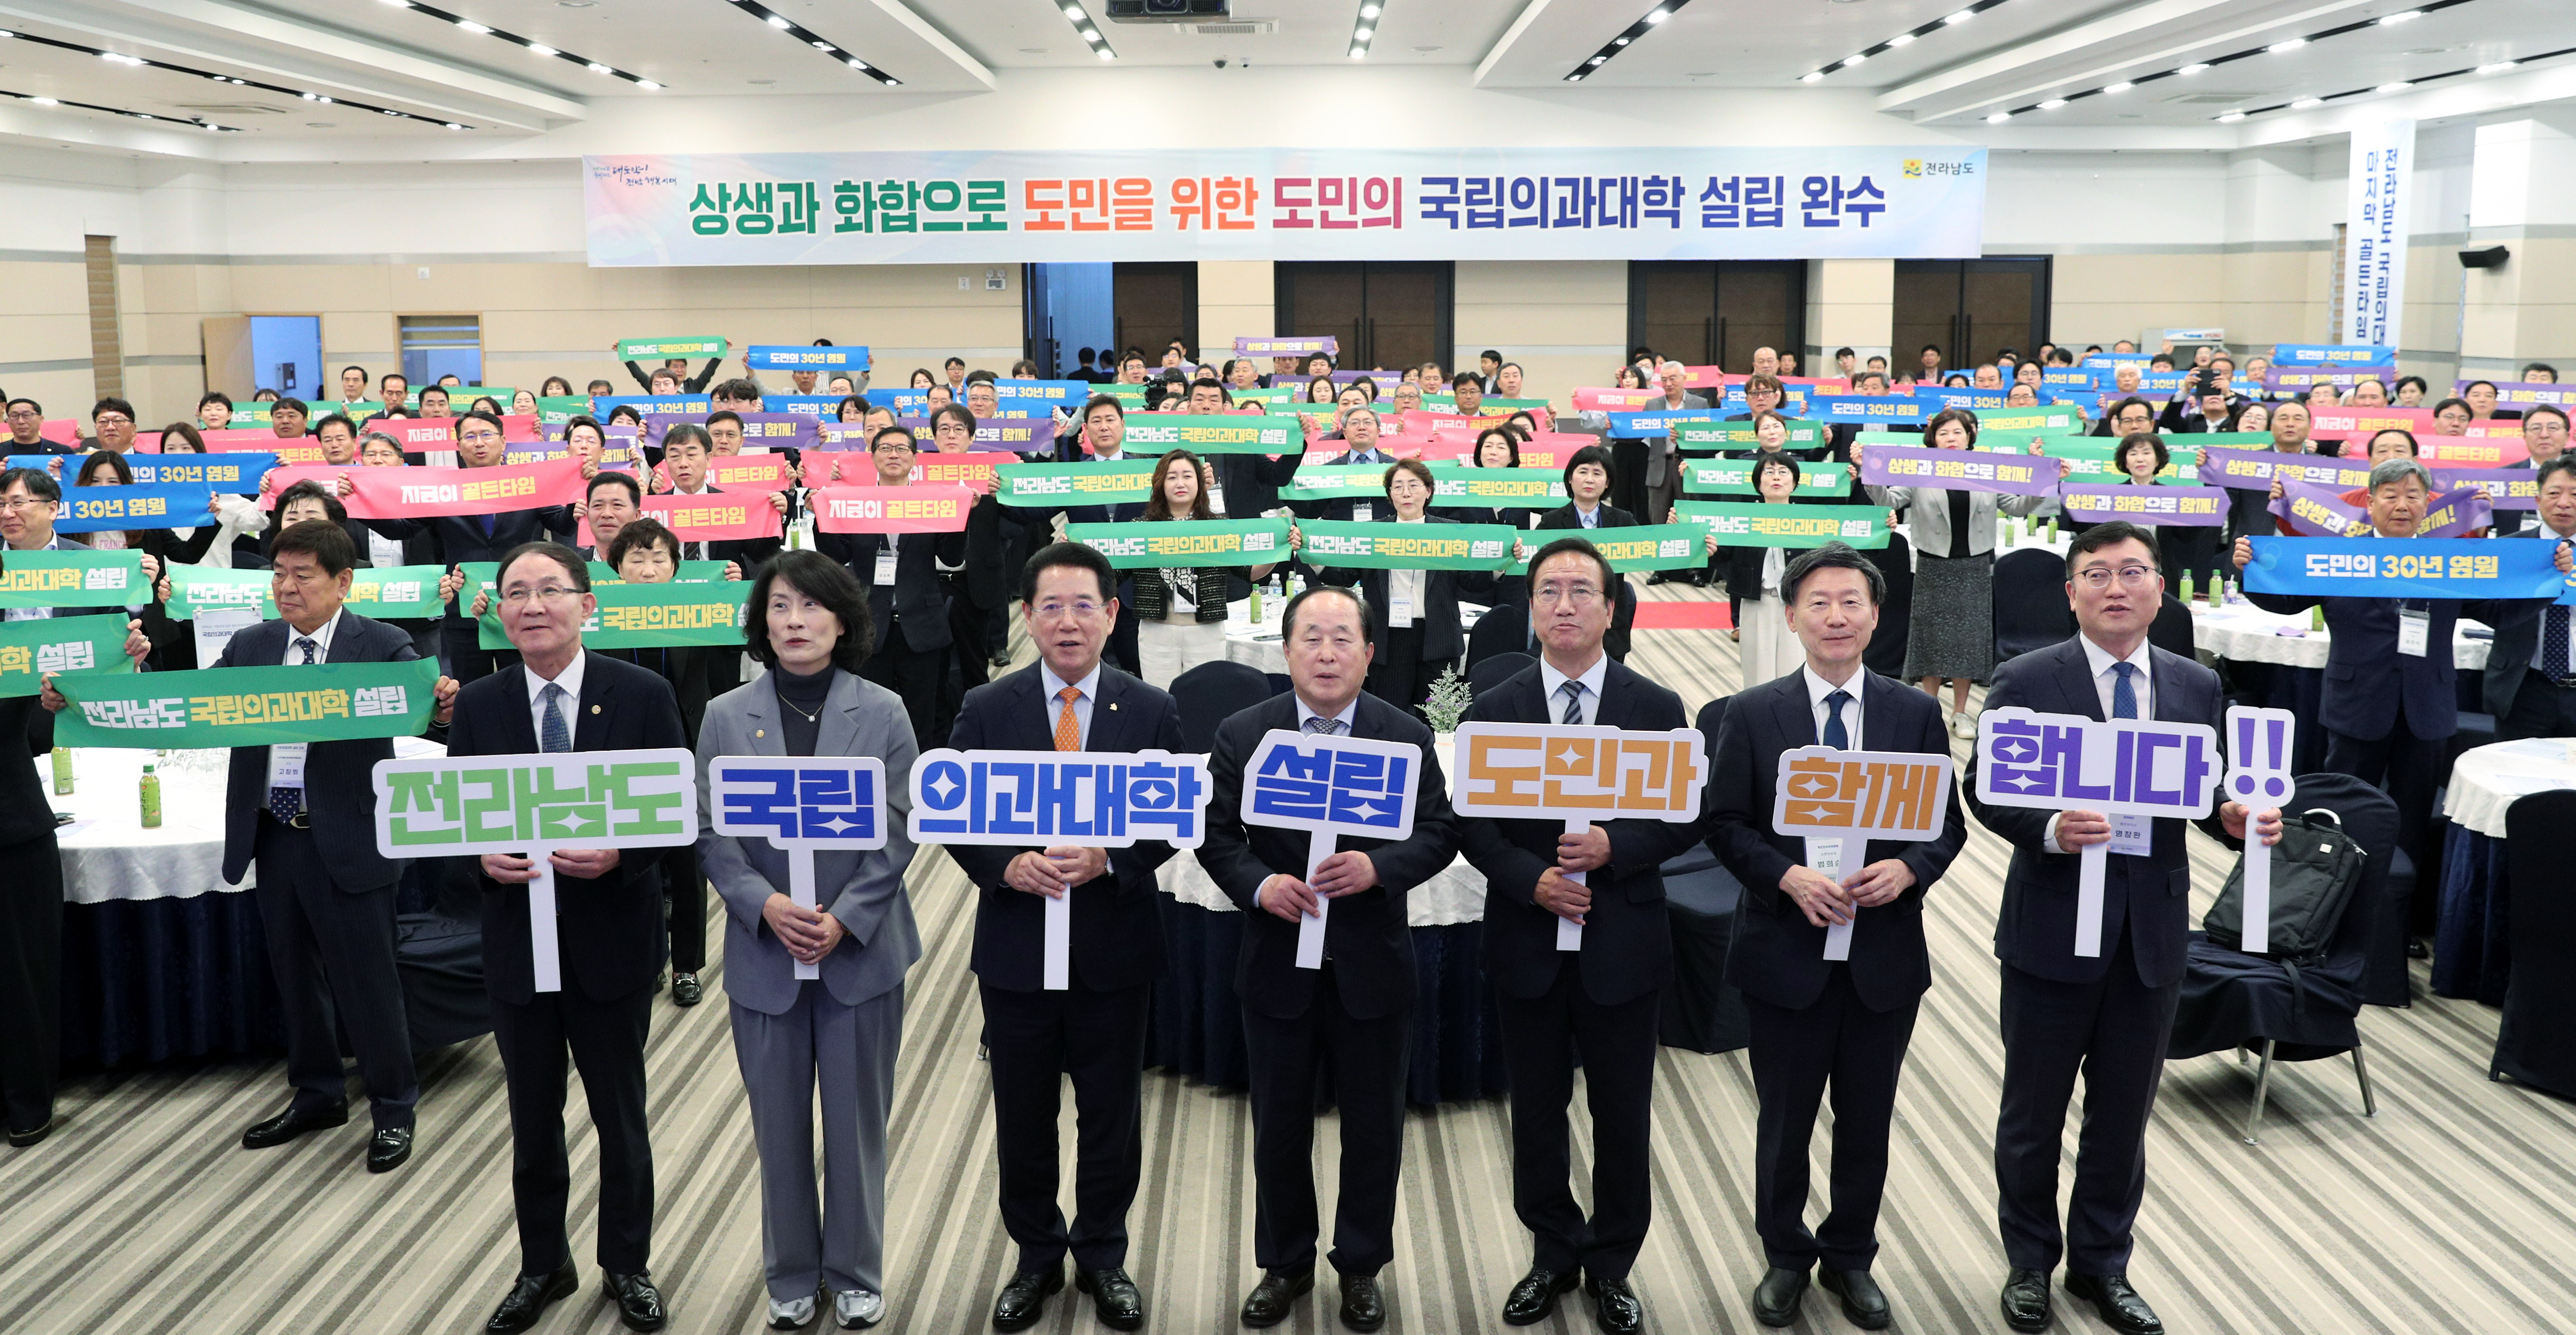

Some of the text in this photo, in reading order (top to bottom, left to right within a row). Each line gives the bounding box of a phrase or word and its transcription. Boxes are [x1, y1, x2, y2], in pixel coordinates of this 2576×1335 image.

[1925, 161, 1975, 175] 전라남도
[689, 174, 1887, 235] 상생과 화합으로 도민을 위한 도민의 국립의과대학 설립 완수
[2381, 147, 2398, 243] 전라남도
[2356, 150, 2379, 339] 마지막 골든타임
[627, 343, 718, 355] 전라남도 국립의과대학 설립
[1246, 340, 1323, 351] 상생과 화합으로 함께!
[770, 352, 846, 364] 도민의 30년 염원
[2295, 350, 2325, 361] 도민의
[2325, 350, 2351, 361] 30년
[2043, 374, 2067, 385] 30년
[2150, 378, 2177, 389] 30년
[2279, 375, 2310, 385] 상생과
[997, 386, 1065, 399] 민의 30년 염원
[1598, 395, 1625, 405] 지금이
[1728, 390, 1747, 401] 도민
[655, 402, 684, 414] 30년
[685, 402, 707, 414] 염원
[787, 403, 838, 415] 도민의 30
[1831, 402, 1919, 416] 도민의 30년 염원
[1973, 396, 2002, 409] 30년
[764, 422, 797, 437] 함께!
[1632, 418, 1662, 430] 도민의
[1983, 414, 2070, 431] 국립의과대학 설립
[2314, 417, 2414, 432] 지금이 골든타임
[407, 427, 447, 443] 지금이
[1002, 427, 1032, 442] 함께!
[1125, 426, 1288, 445] 전라남도 국립의과대학 설립
[1685, 429, 1813, 442] 전라남도 설립
[2438, 446, 2501, 462] 골든타임
[159, 465, 240, 484] 30년 염원
[718, 464, 779, 484] 골든타임
[928, 464, 990, 481] 골든타임
[1696, 469, 1837, 488] 전라남도 설립
[1888, 457, 2034, 484] 상생과 화합으로 함께!
[2225, 459, 2273, 478] 상생과
[2337, 469, 2371, 487] 함께
[401, 476, 537, 505] 지금이 골든타임
[1012, 475, 1072, 495] 전라남도
[1294, 474, 1345, 490] 전라남도
[1468, 480, 1549, 497] 국립의과대학
[75, 499, 125, 519] 30년
[127, 496, 167, 517] 염원
[828, 499, 958, 519] 지금이 골든타임
[2064, 493, 2220, 515] 상생과 화합으로 함께!
[673, 506, 746, 528] 골든타임
[2291, 496, 2347, 534] 상생과
[1751, 517, 1872, 538] 국립의과대학 설립
[1147, 533, 1242, 556] 국립의과대학
[1242, 532, 1275, 551] 설립
[1308, 534, 1504, 559] 전라남도 국립의과대학 설립
[1658, 539, 1691, 558] 설립
[2305, 553, 2499, 579] 도민의 30년 염원
[84, 567, 128, 590] 설립
[186, 581, 264, 605] 전라남도
[381, 580, 421, 603] 설립
[602, 605, 735, 632] 국립의과대학
[36, 639, 95, 673] 설립
[78, 685, 409, 729] 전라남도 국립의과대학 설립
[1989, 718, 2210, 808] 합니다
[2235, 717, 2285, 798] !!
[1466, 734, 1697, 811] 도민과
[1252, 743, 1409, 829] 설립
[1783, 756, 1940, 831] 함께
[386, 761, 685, 847] 전라남도
[721, 768, 876, 839] 국립
[919, 760, 1202, 838] 의과대학
